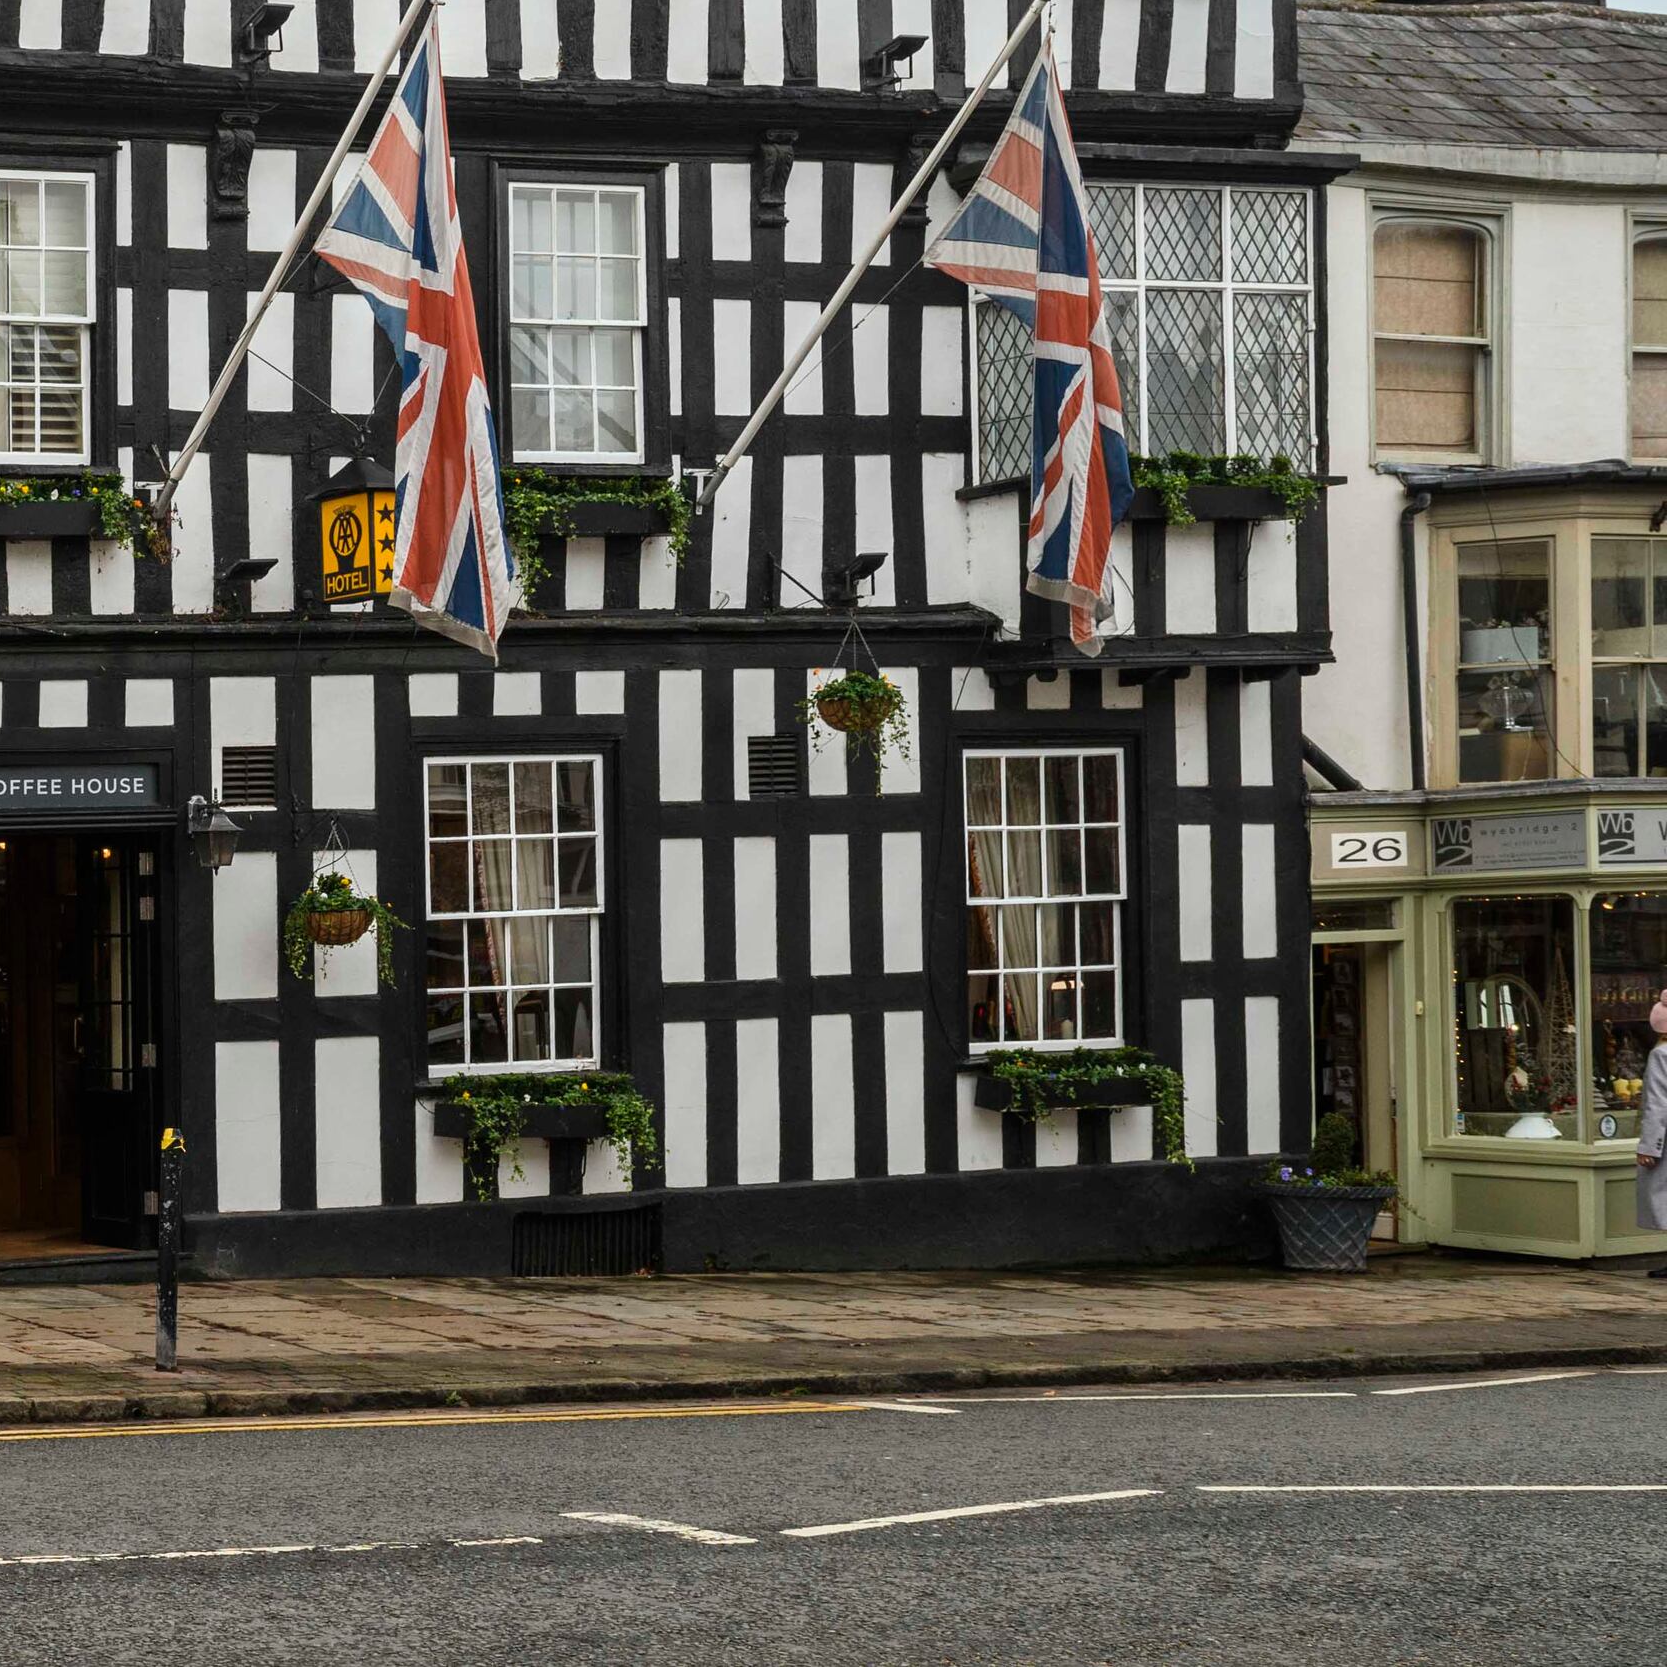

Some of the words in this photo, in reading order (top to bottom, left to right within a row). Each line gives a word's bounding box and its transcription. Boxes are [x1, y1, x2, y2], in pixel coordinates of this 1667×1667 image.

[327, 570, 367, 595] HOTEL
[71, 777, 145, 795] HOUSE
[1480, 823, 1560, 837] wyebridge
[1570, 822, 1578, 831] 2
[1338, 837, 1402, 863] 26
